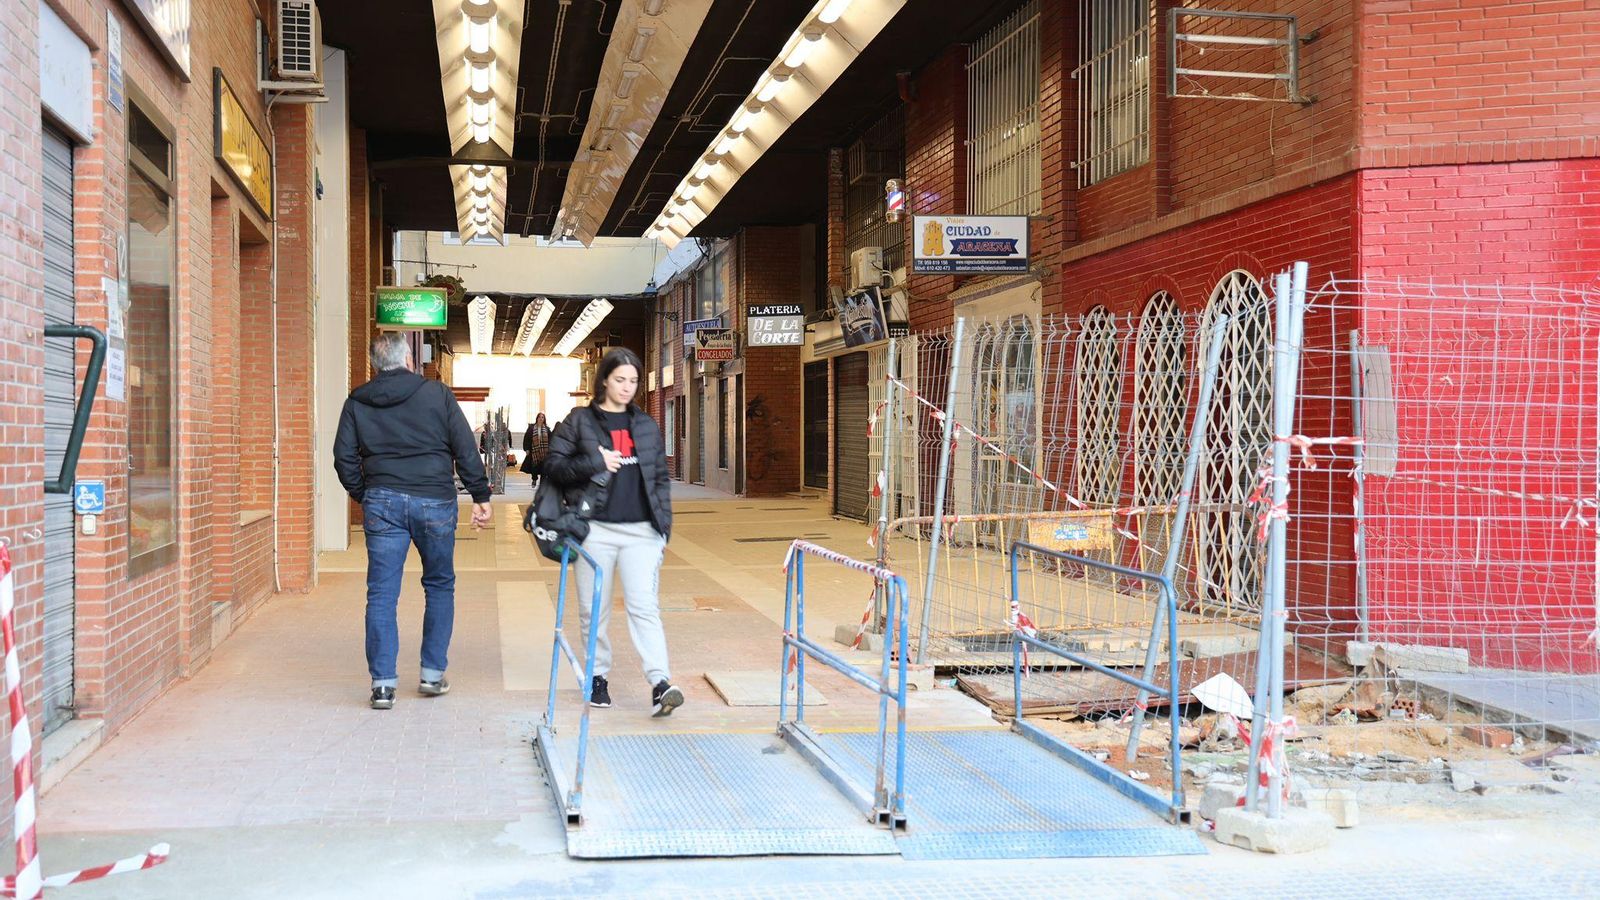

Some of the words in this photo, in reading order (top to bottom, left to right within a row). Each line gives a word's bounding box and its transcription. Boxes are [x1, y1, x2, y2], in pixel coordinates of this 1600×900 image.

[946, 225, 991, 236] CIUDAD
[957, 242, 1012, 252] ARACENA
[384, 300, 416, 312] NOCHE
[750, 305, 801, 314] PLATERIA
[754, 318, 774, 331] DE
[781, 318, 799, 331] LA
[753, 331, 800, 344] CORTE
[698, 350, 732, 359] CONGELADOS
